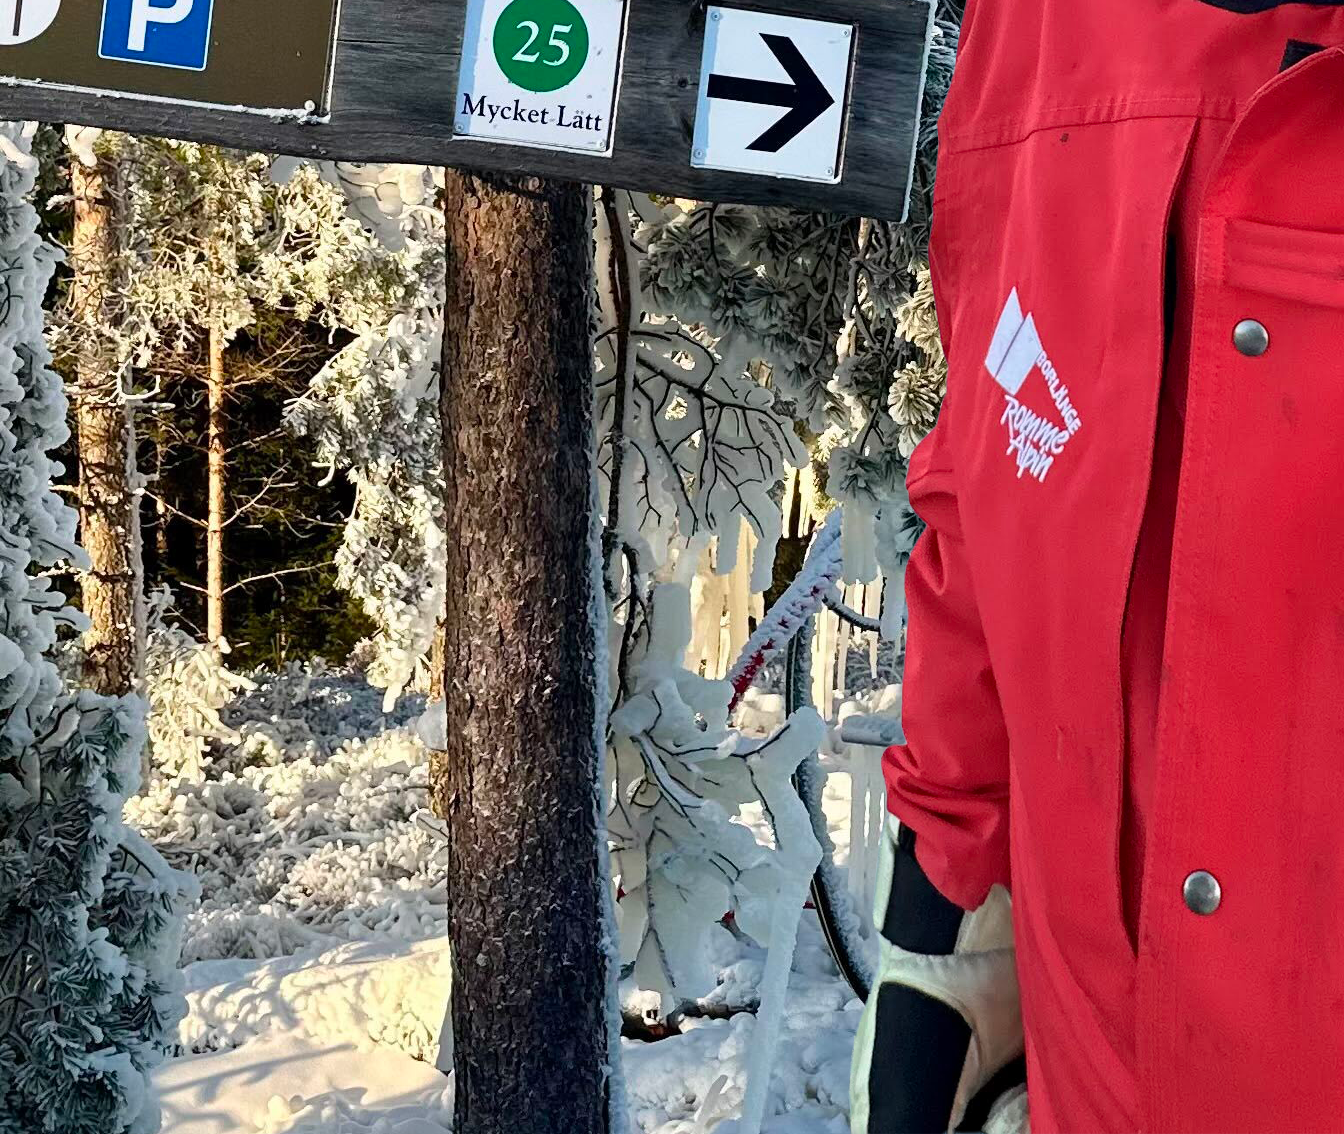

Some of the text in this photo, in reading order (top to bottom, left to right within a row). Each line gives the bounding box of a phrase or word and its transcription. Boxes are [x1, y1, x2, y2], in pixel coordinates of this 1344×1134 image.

[511, 20, 573, 67] 25
[461, 92, 603, 132] Mycket Lätt
[999, 394, 1071, 455] Romme
[1005, 433, 1055, 484] Alpin
